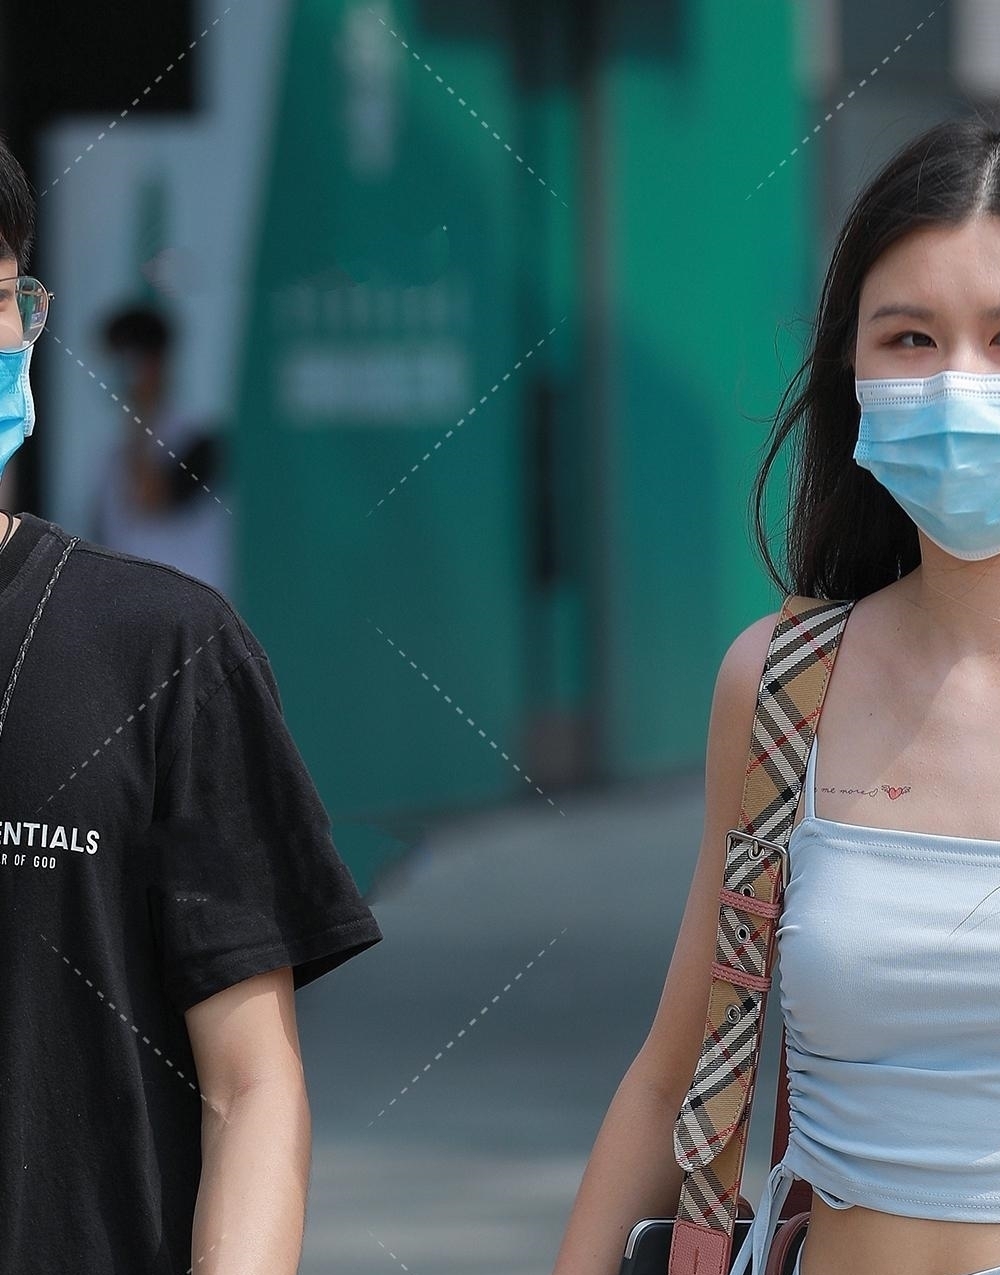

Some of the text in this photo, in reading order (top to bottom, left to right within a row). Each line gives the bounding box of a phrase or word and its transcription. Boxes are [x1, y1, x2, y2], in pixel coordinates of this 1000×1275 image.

[0, 821, 100, 855] NTIALS
[14, 854, 27, 866] OF
[33, 855, 56, 869] GOD
